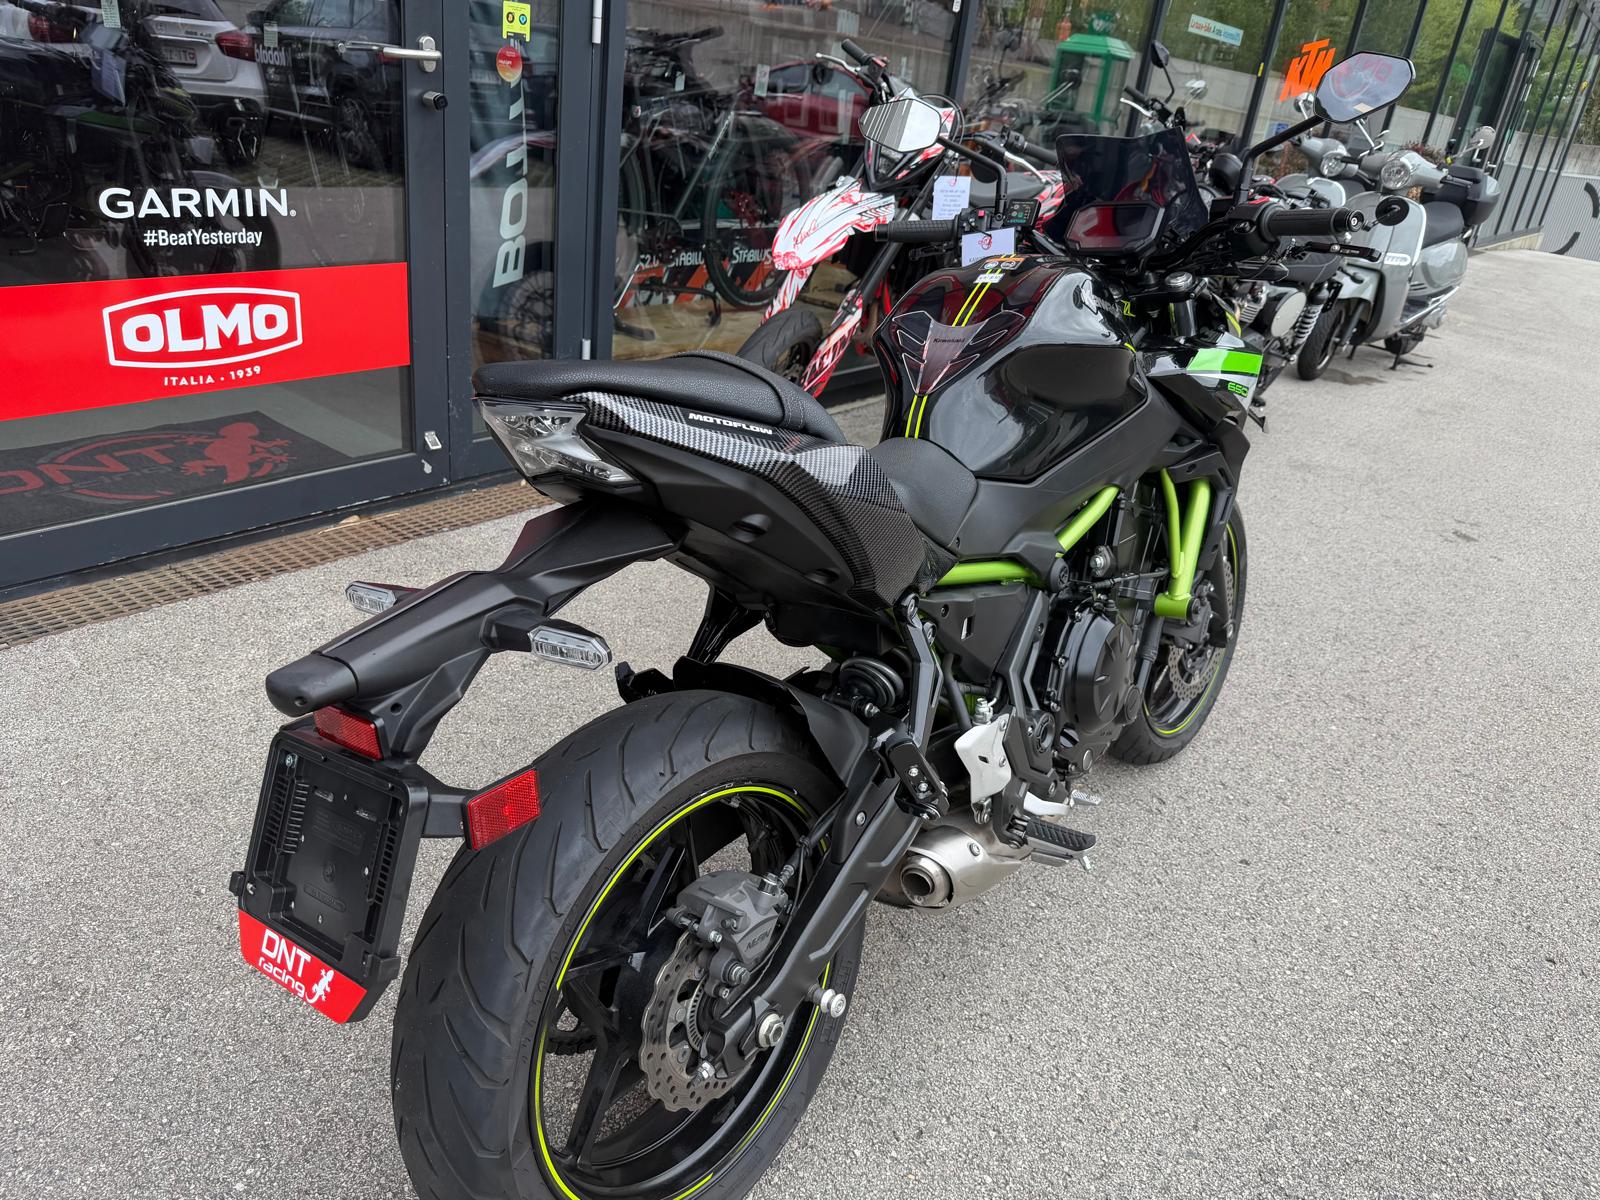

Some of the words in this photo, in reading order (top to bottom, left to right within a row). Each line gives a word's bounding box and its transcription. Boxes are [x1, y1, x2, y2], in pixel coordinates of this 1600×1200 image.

[1280, 38, 1336, 102] KTM
[143, 228, 263, 247] #BeatYesterday
[121, 302, 289, 353] OLMO
[163, 374, 215, 387] ITALIA
[229, 365, 262, 381] 1939
[1227, 382, 1249, 397] 650
[688, 412, 773, 436] MOTOFLOW
[261, 928, 311, 978] DNT
[257, 957, 306, 998] racing
